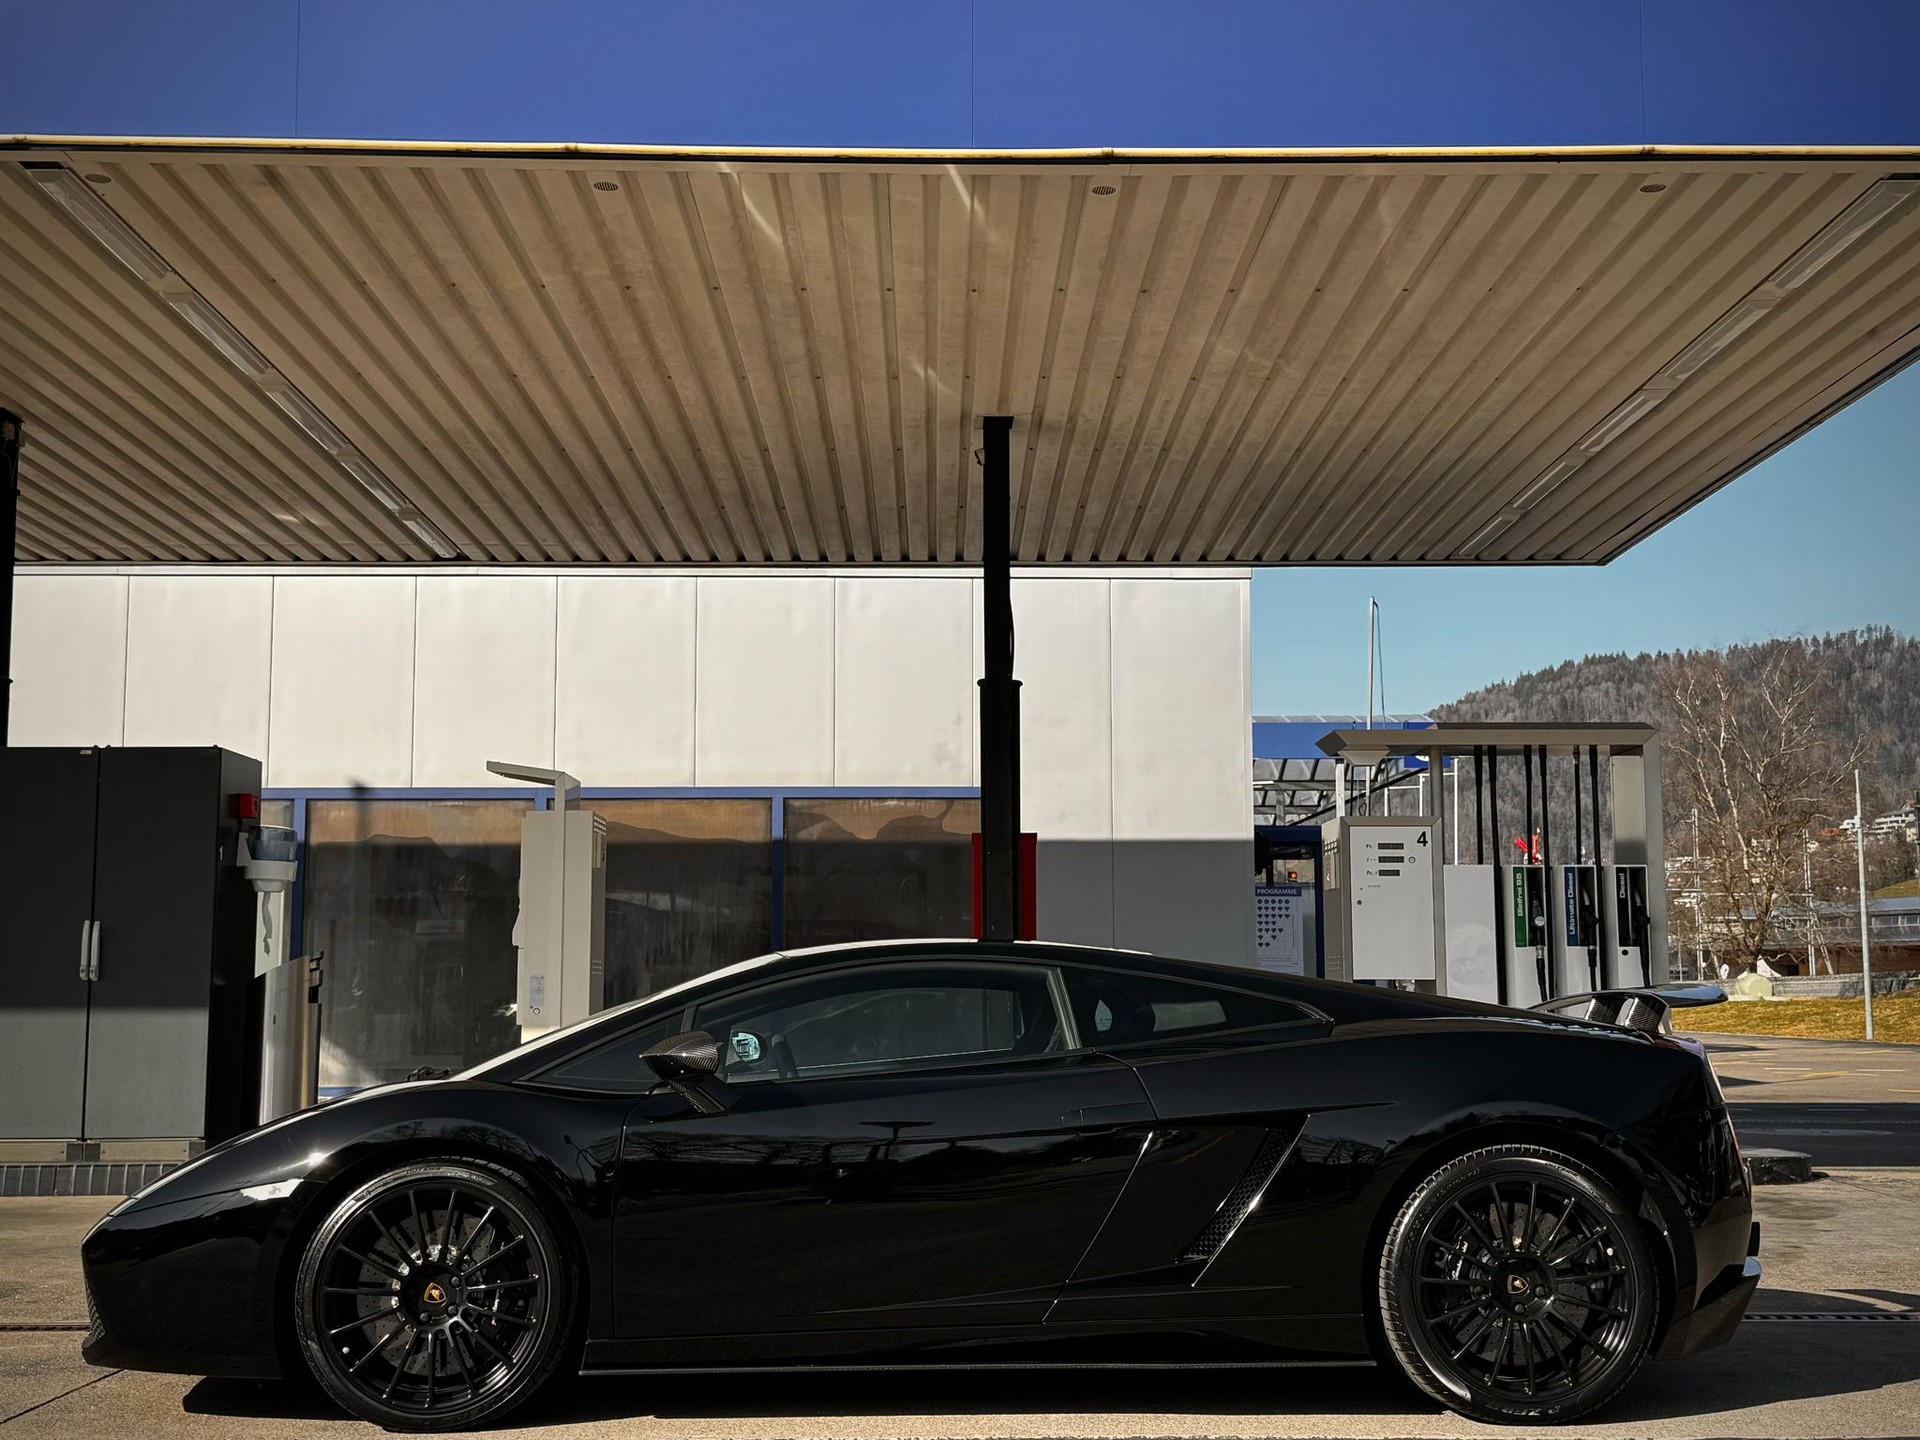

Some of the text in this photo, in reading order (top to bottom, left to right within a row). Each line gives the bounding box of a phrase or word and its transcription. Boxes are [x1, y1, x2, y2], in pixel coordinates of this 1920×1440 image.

[1416, 831, 1428, 847] 4
[1515, 873, 1524, 917] Bleifrei 95
[1618, 873, 1626, 898] Diesel
[1568, 899, 1576, 935] Ultimate
